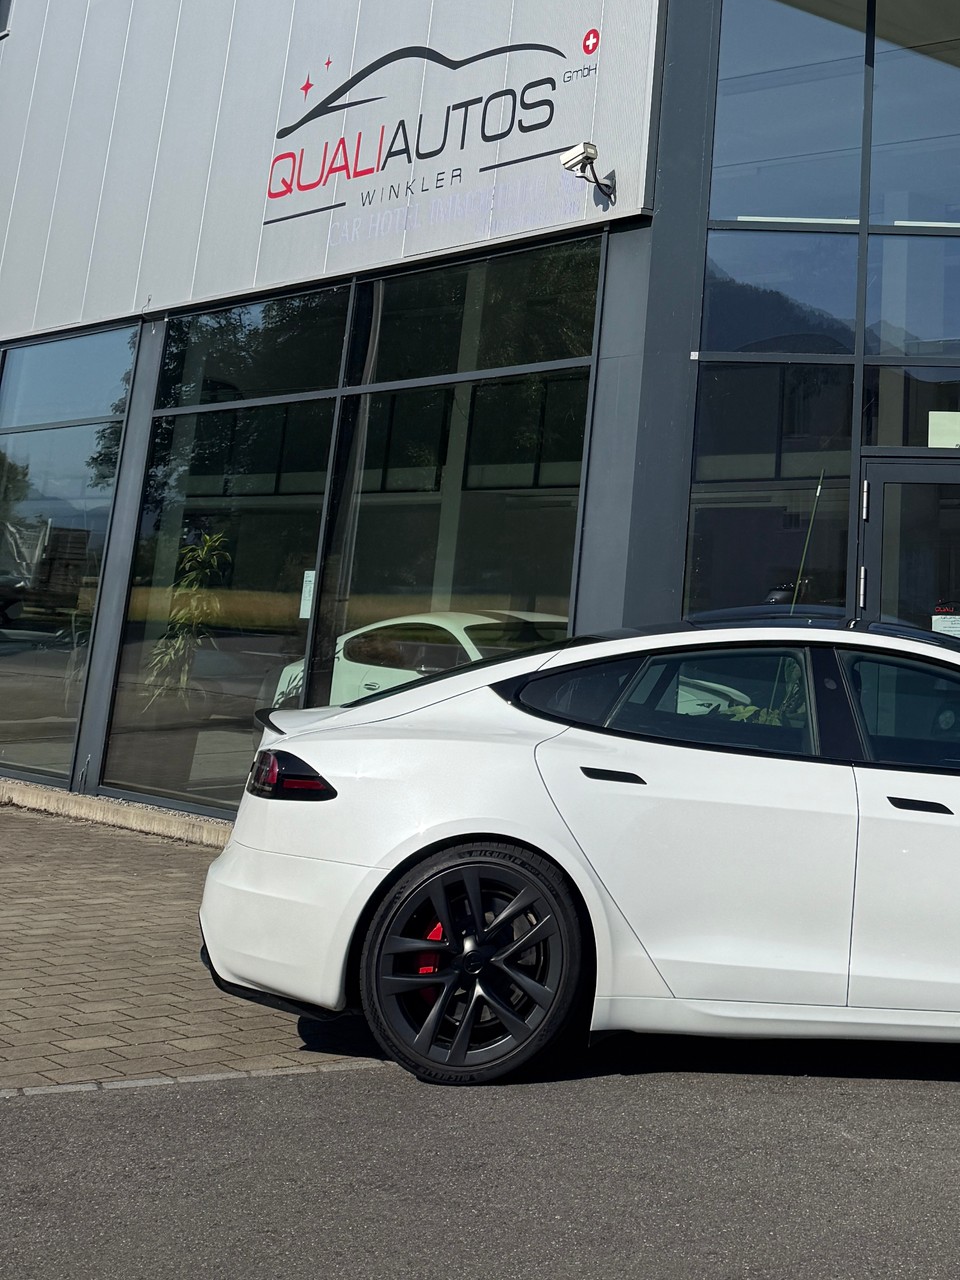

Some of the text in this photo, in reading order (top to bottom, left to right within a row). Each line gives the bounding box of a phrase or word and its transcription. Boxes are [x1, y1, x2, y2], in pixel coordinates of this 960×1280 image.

[267, 77, 557, 200] QUALIAUTOS
[360, 167, 463, 207] WINKLER
[471, 849, 523, 866] MICHELIN
